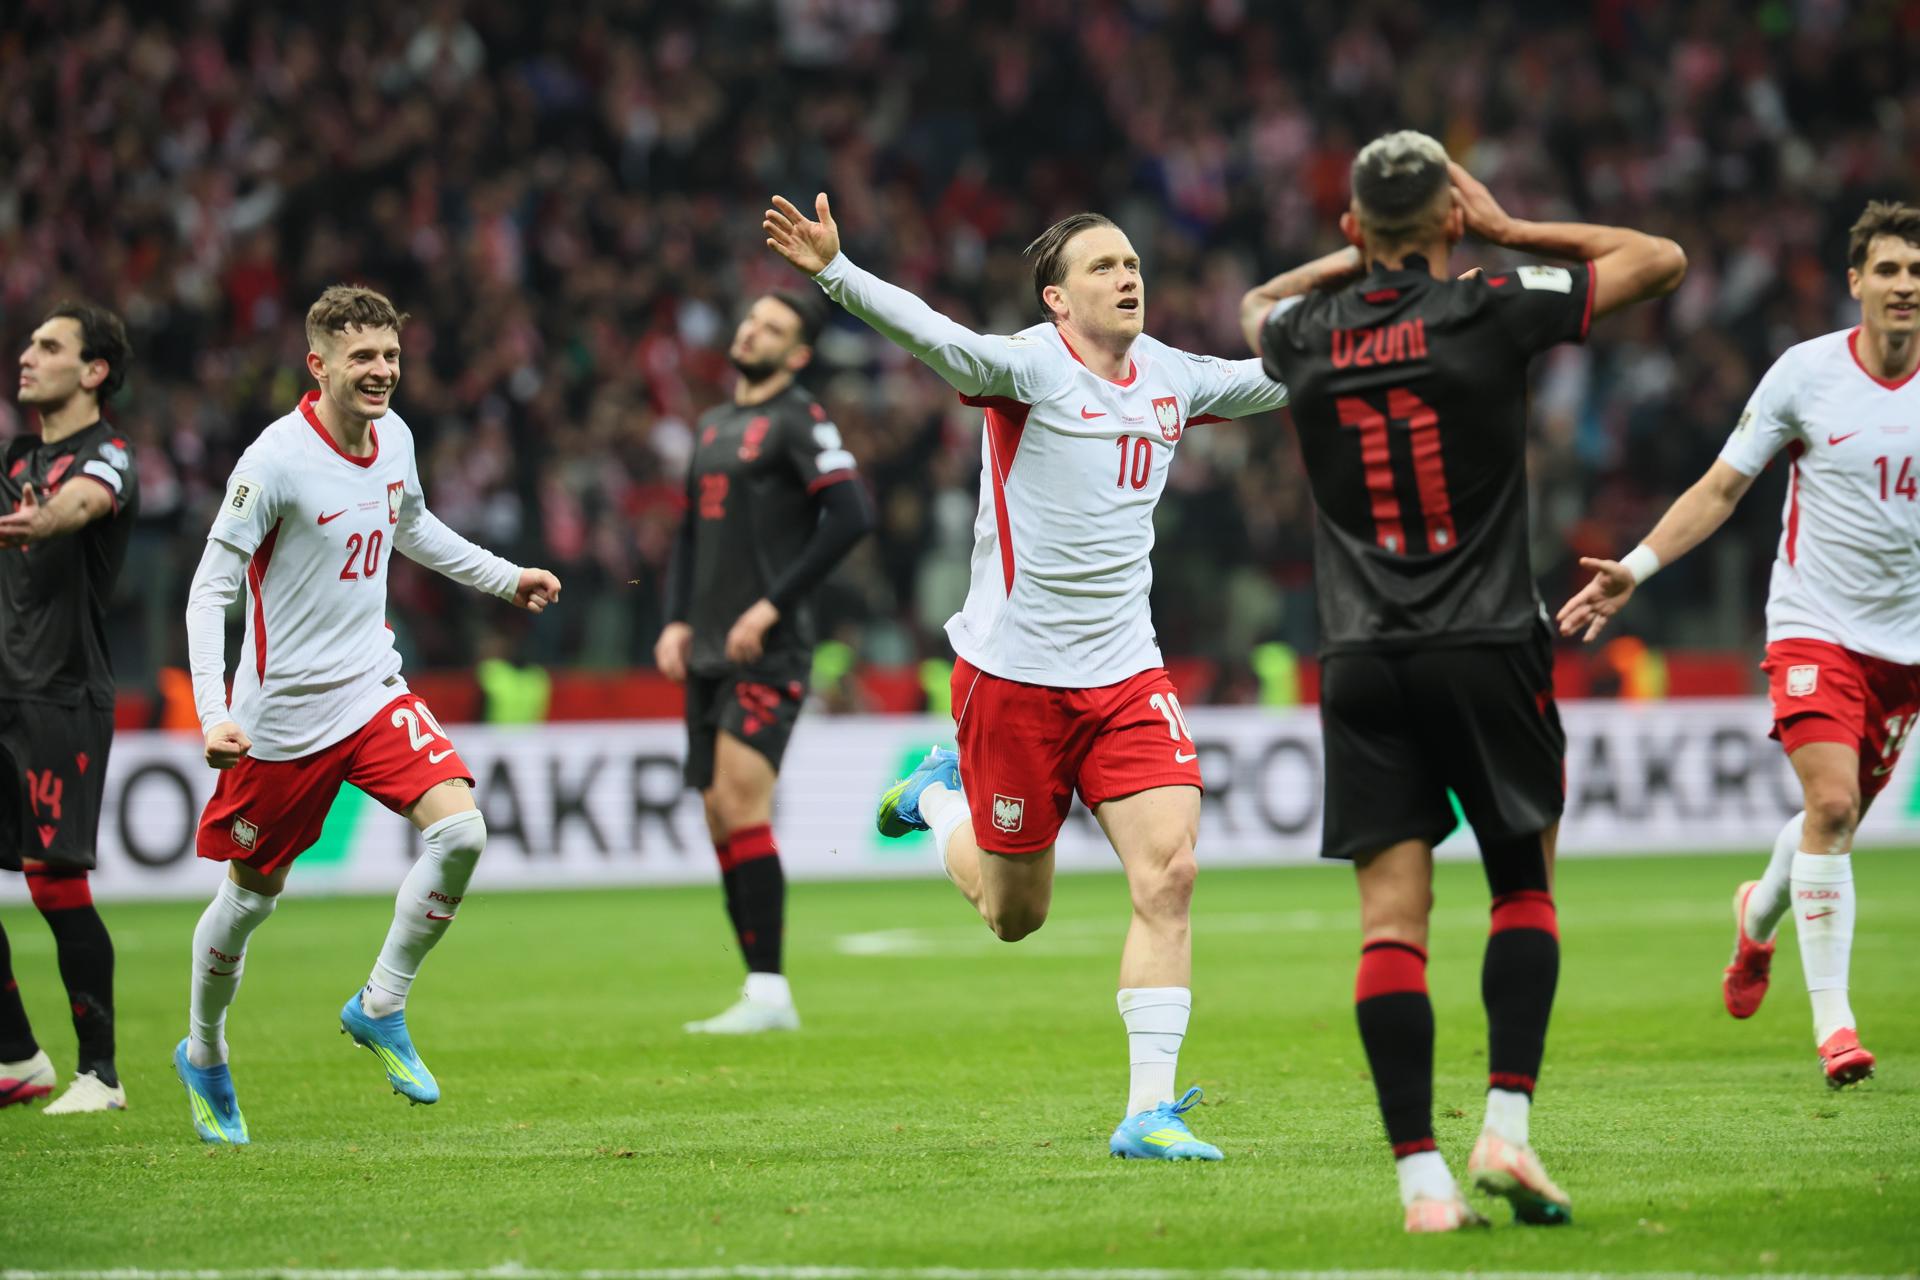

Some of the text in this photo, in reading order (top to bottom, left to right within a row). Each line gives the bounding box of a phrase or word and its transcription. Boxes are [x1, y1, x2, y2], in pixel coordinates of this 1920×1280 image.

[1331, 317, 1427, 368] UZUNI
[1116, 435, 1152, 491] 10
[1336, 388, 1457, 556] 11
[1874, 455, 1918, 502] 14
[340, 529, 384, 581] 20
[391, 701, 448, 751] 20
[25, 767, 63, 820] 14
